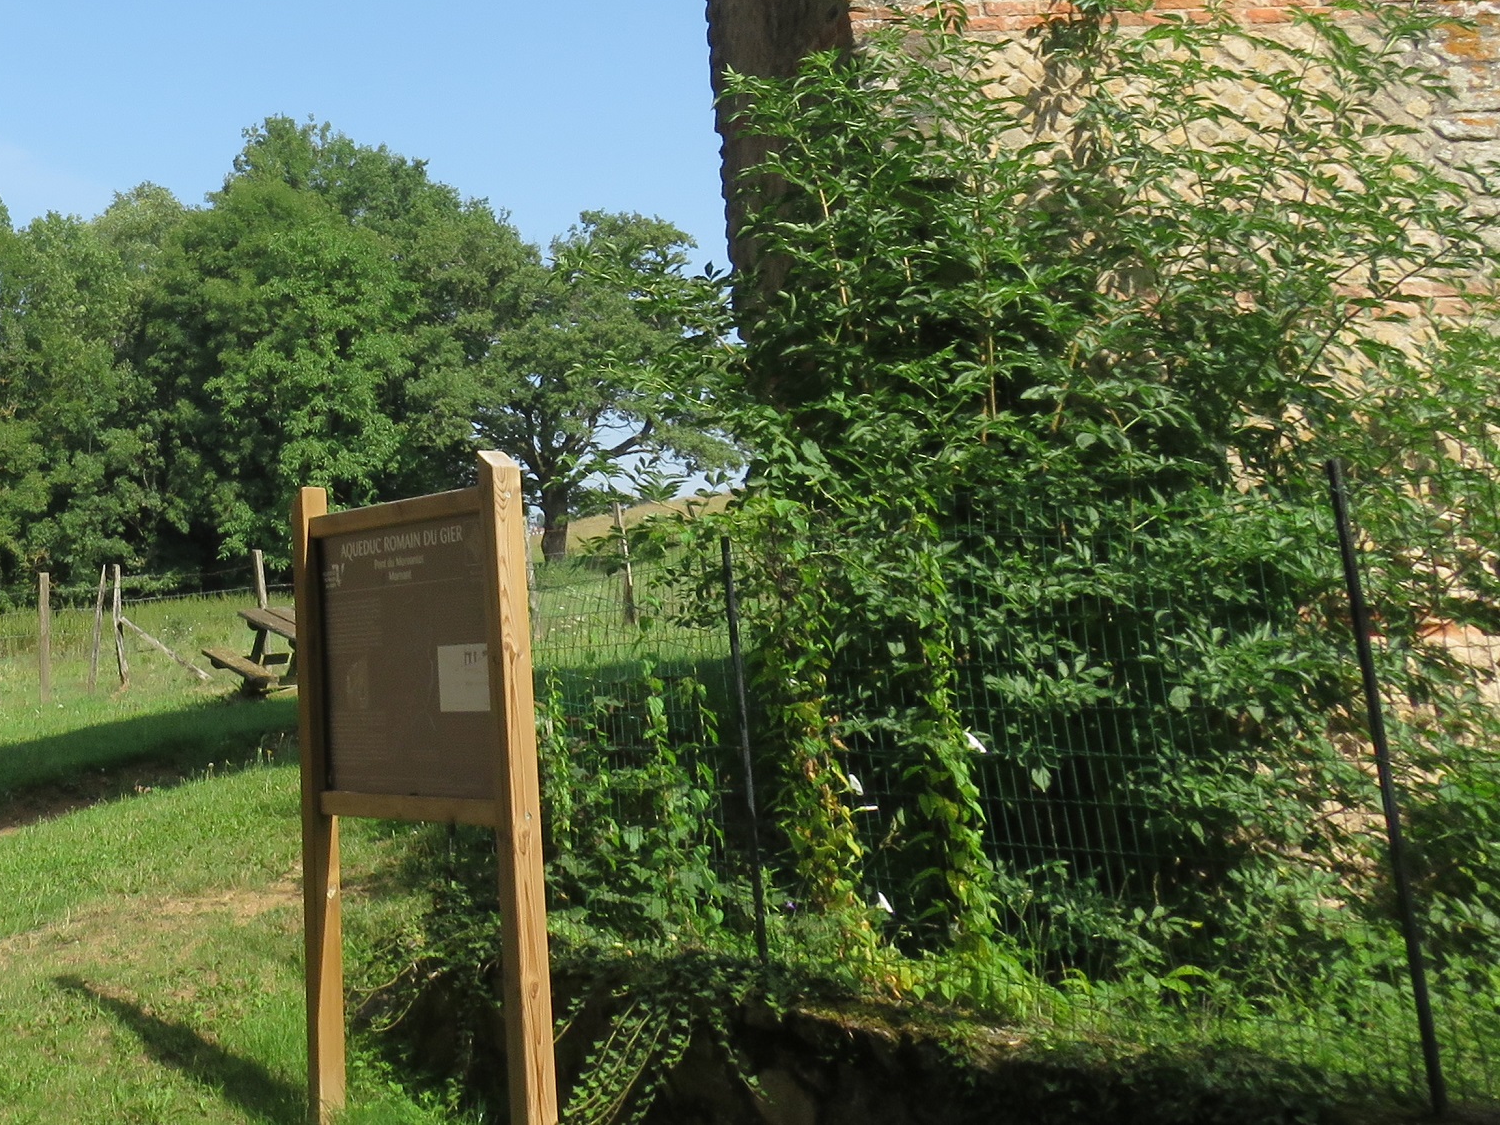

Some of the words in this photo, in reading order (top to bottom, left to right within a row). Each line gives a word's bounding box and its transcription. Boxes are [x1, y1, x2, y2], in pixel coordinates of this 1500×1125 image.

[341, 538, 381, 561] AQUEDUC
[385, 532, 420, 551] ROMAIN
[424, 530, 436, 545] DU
[440, 525, 463, 543] GIER
